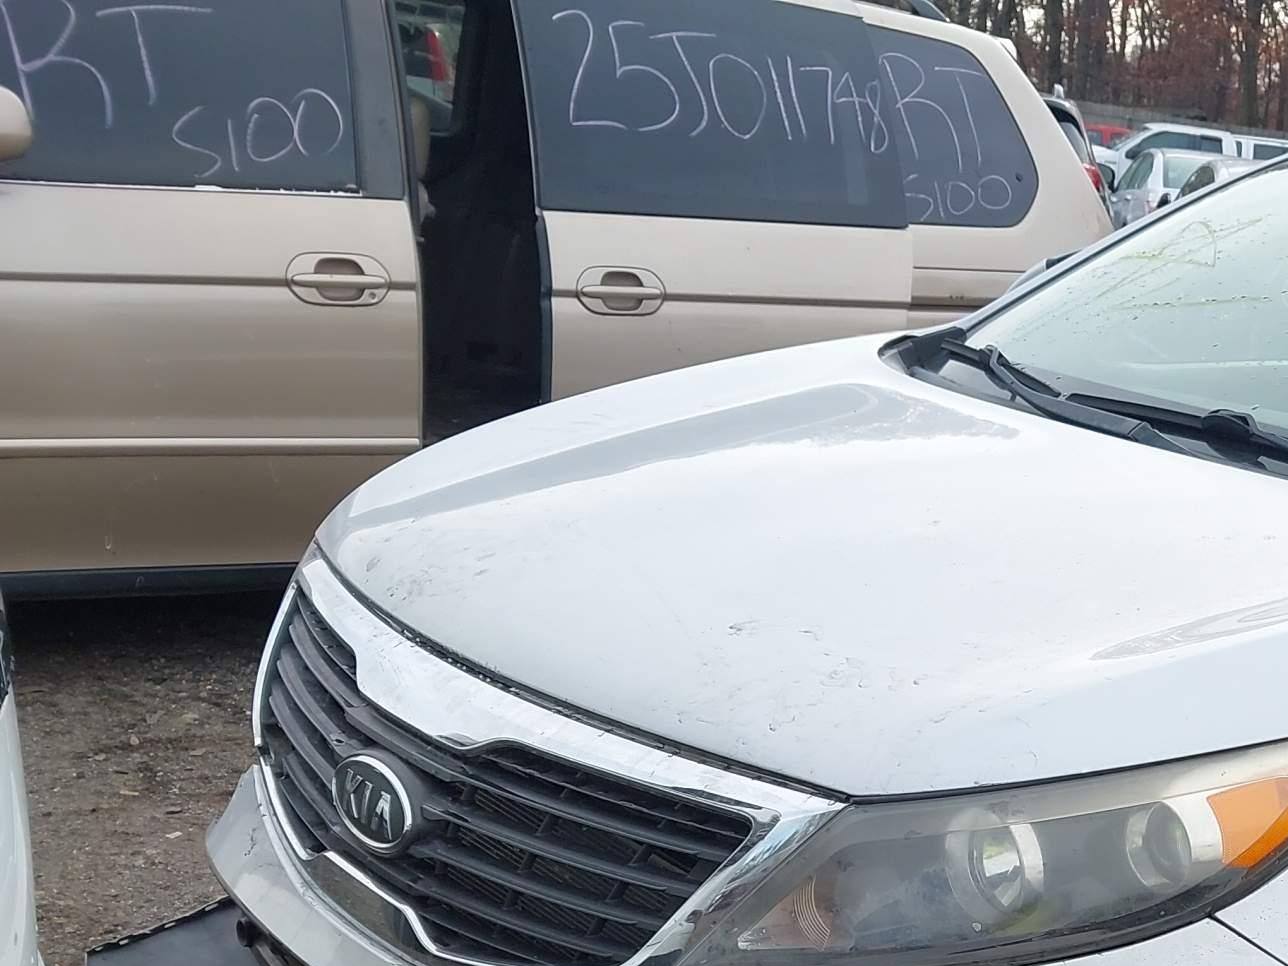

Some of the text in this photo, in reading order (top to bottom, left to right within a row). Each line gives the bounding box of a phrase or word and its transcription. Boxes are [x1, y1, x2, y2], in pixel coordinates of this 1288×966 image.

[552, 9, 890, 154] 25J011748
[878, 53, 988, 173] RT
[172, 88, 344, 178] S100
[904, 173, 1013, 223] S100
[341, 767, 394, 841] KIA
